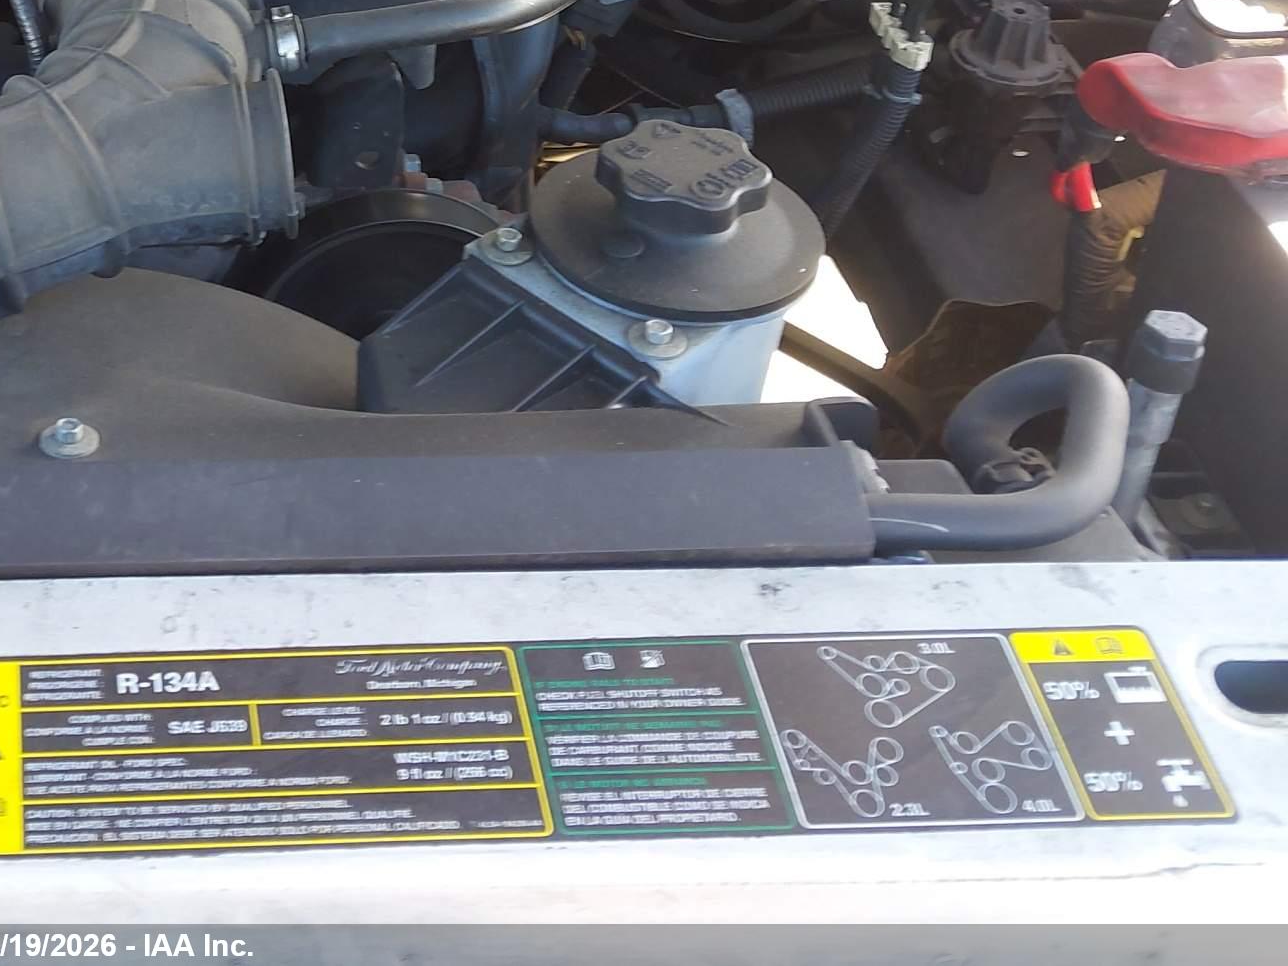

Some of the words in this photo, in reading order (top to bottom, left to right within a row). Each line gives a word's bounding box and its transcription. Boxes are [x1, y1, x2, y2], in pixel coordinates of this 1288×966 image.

[917, 642, 956, 655] 3.0L
[335, 659, 377, 675] Ford
[375, 658, 422, 678] Motor
[116, 670, 219, 695] R-134A
[1043, 681, 1100, 701] 50%
[168, 720, 205, 735] SAE
[380, 715, 388, 726] 2
[392, 714, 408, 725] lb
[412, 714, 420, 725] 1
[397, 769, 408, 781] 9
[1084, 772, 1144, 794] 50%
[889, 802, 930, 817] 2.3L
